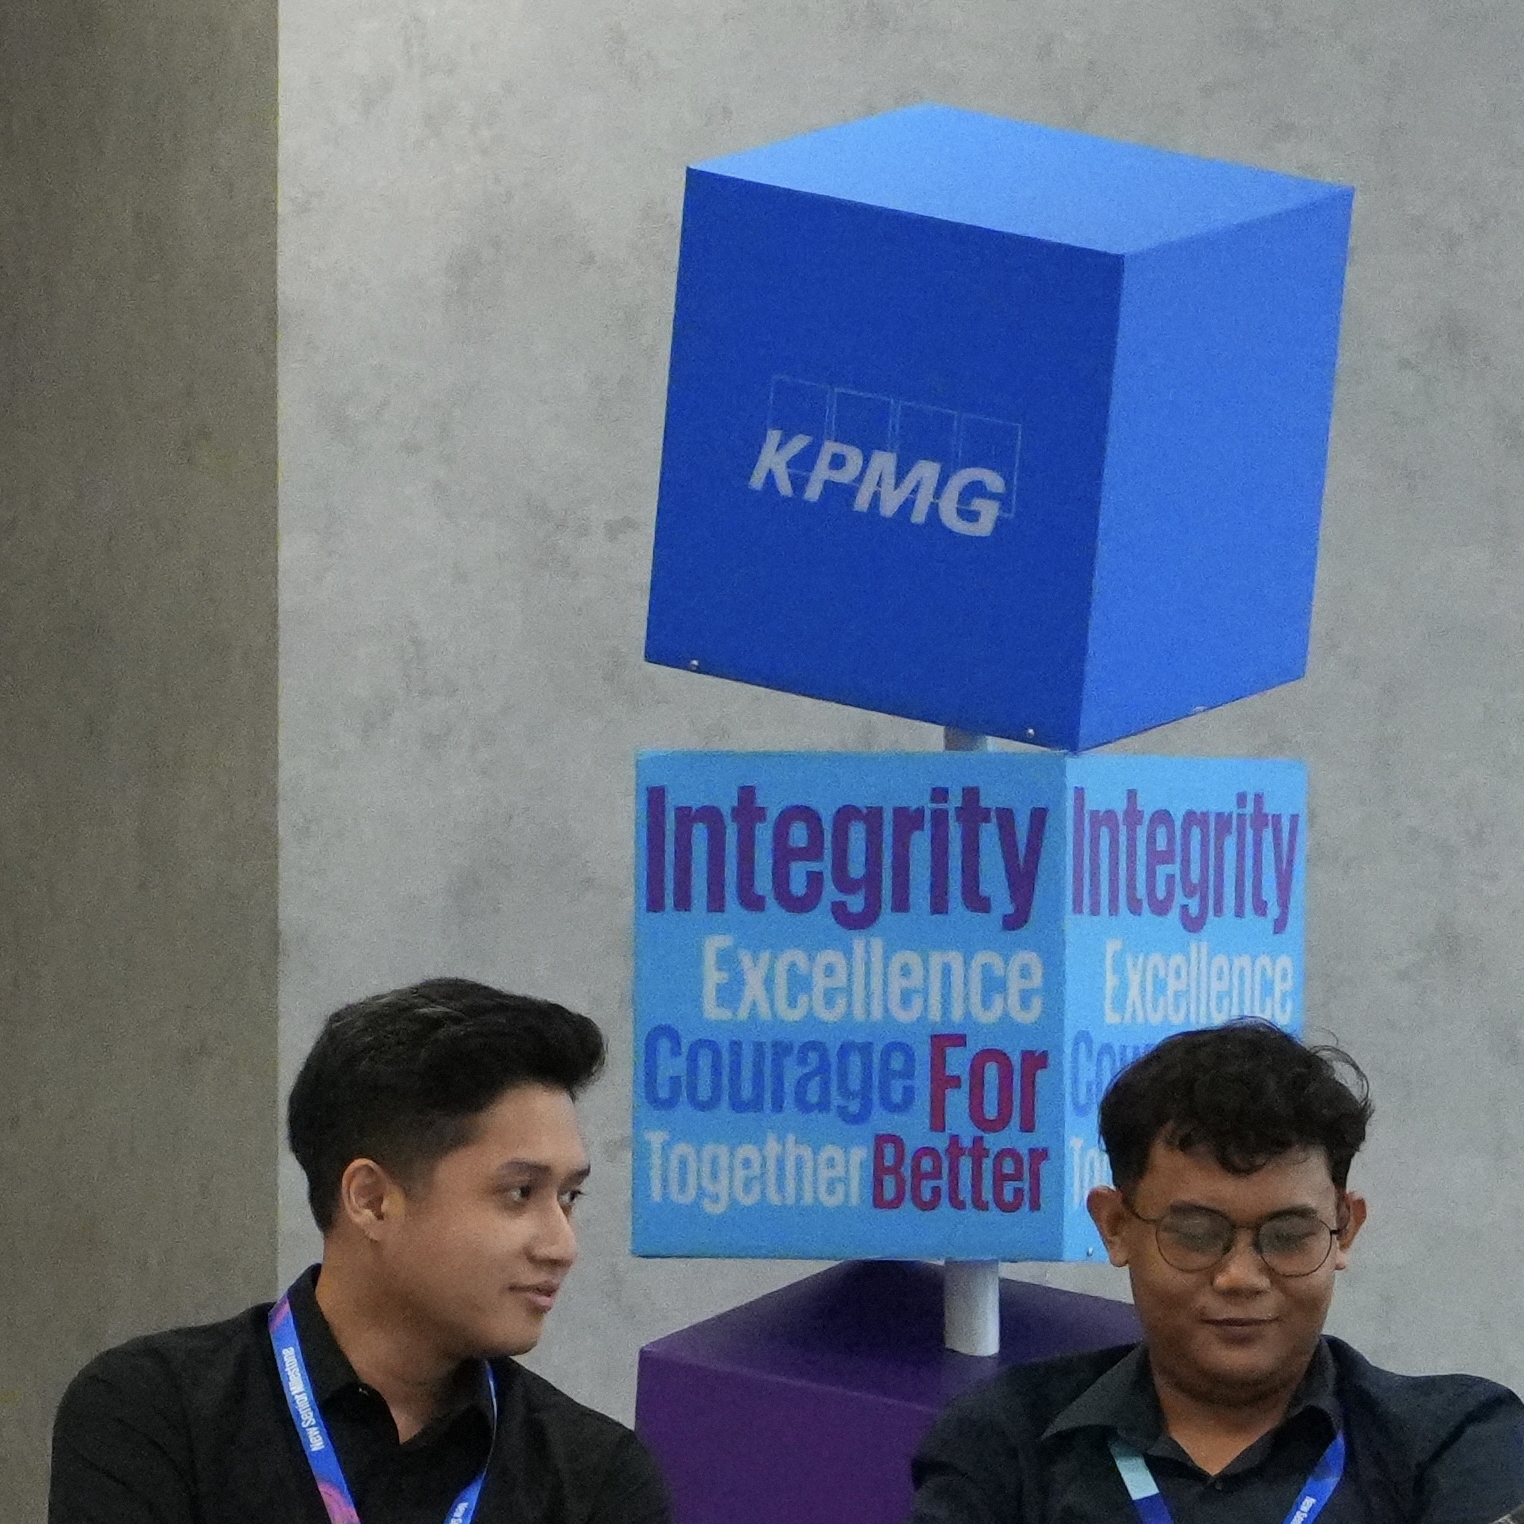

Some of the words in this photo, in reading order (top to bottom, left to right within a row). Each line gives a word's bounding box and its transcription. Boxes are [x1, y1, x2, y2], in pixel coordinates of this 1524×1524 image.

[747, 429, 1007, 538] KPMG
[644, 785, 1049, 931] Integrity
[1071, 786, 1301, 935] Integrity
[701, 934, 1044, 1024] Excellence
[1103, 938, 1294, 1026] Excellence
[643, 1023, 917, 1126] Courage
[928, 1033, 1049, 1133] For
[644, 1130, 867, 1215] Together
[873, 1133, 1049, 1212] Better
[281, 1346, 304, 1395] Milestone
[294, 1392, 316, 1428] Senior
[306, 1426, 324, 1451] New
